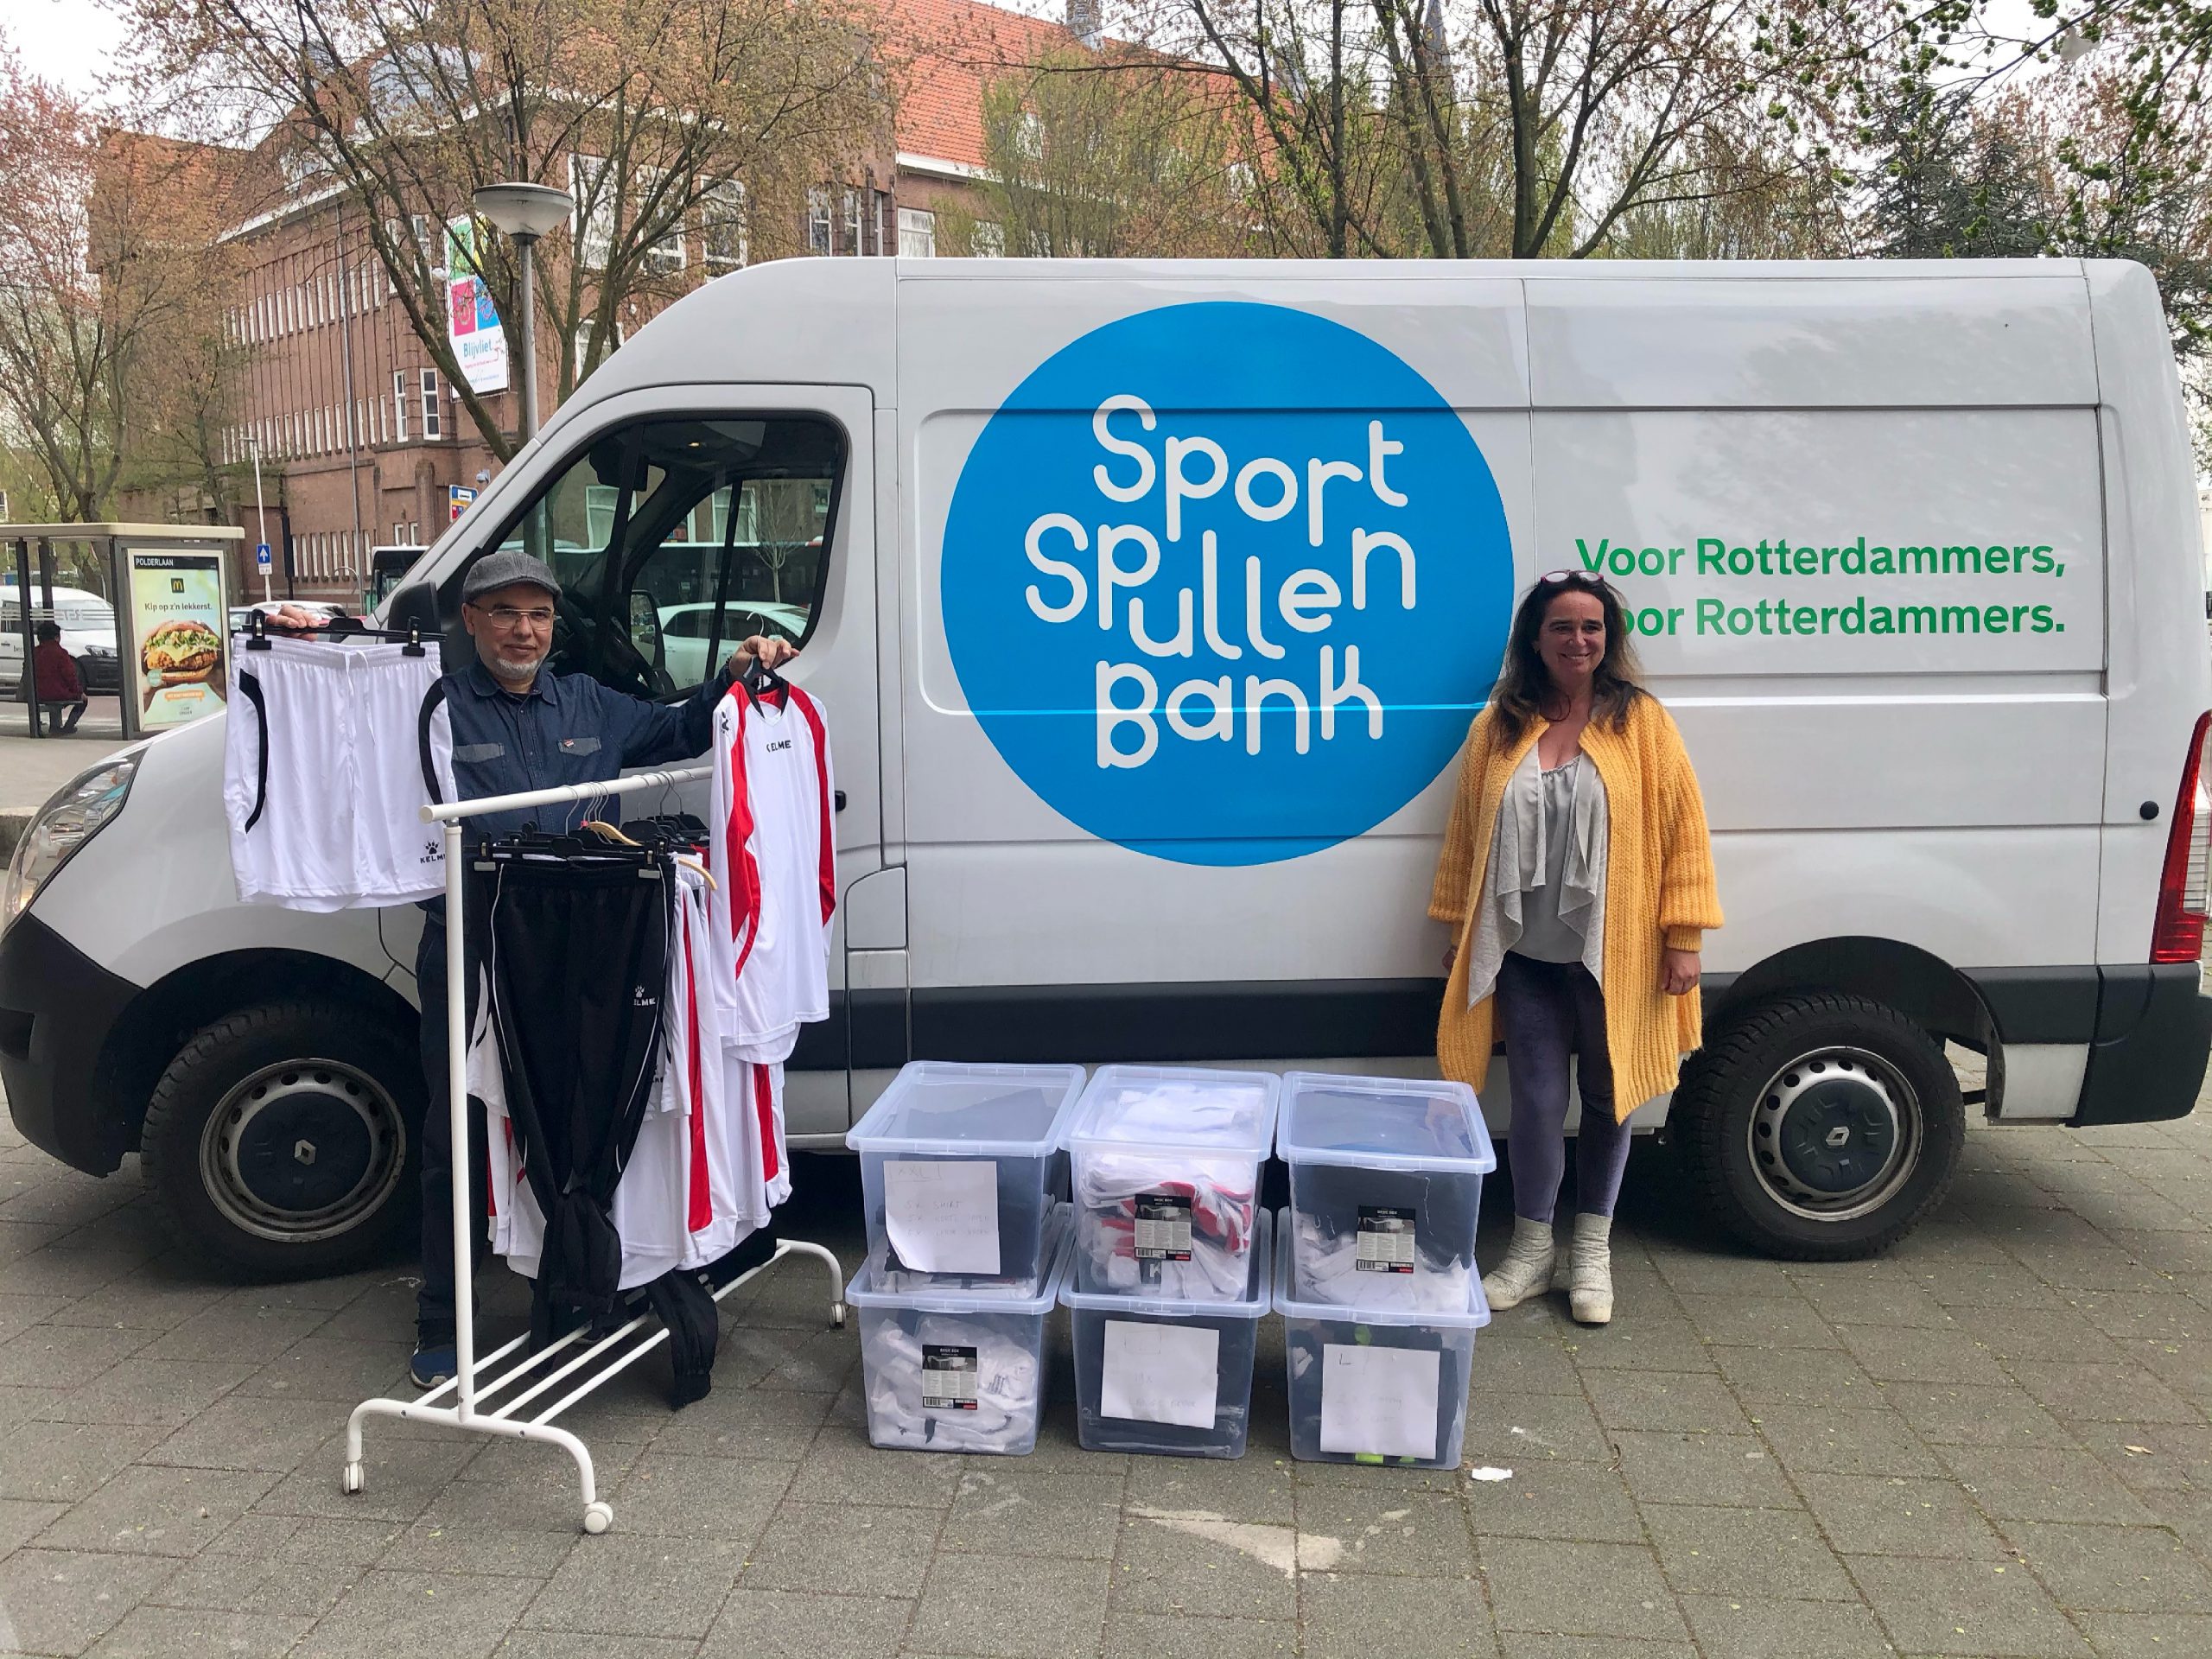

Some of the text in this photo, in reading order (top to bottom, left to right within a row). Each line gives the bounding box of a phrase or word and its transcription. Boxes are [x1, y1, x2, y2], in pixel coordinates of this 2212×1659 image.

[463, 339, 493, 359] Blijvliet
[1093, 394, 1408, 547] Sport
[136, 557, 174, 567] POLDERLAAN
[1575, 535, 2065, 578] Voor Rotterdammers,
[1024, 513, 1416, 660] Spullen
[144, 602, 157, 613] Kip
[181, 602, 213, 611] lekkerst.
[1696, 595, 2065, 635] Rotterdammers.
[1096, 645, 1383, 768] Bank
[420, 853, 446, 864] KELM
